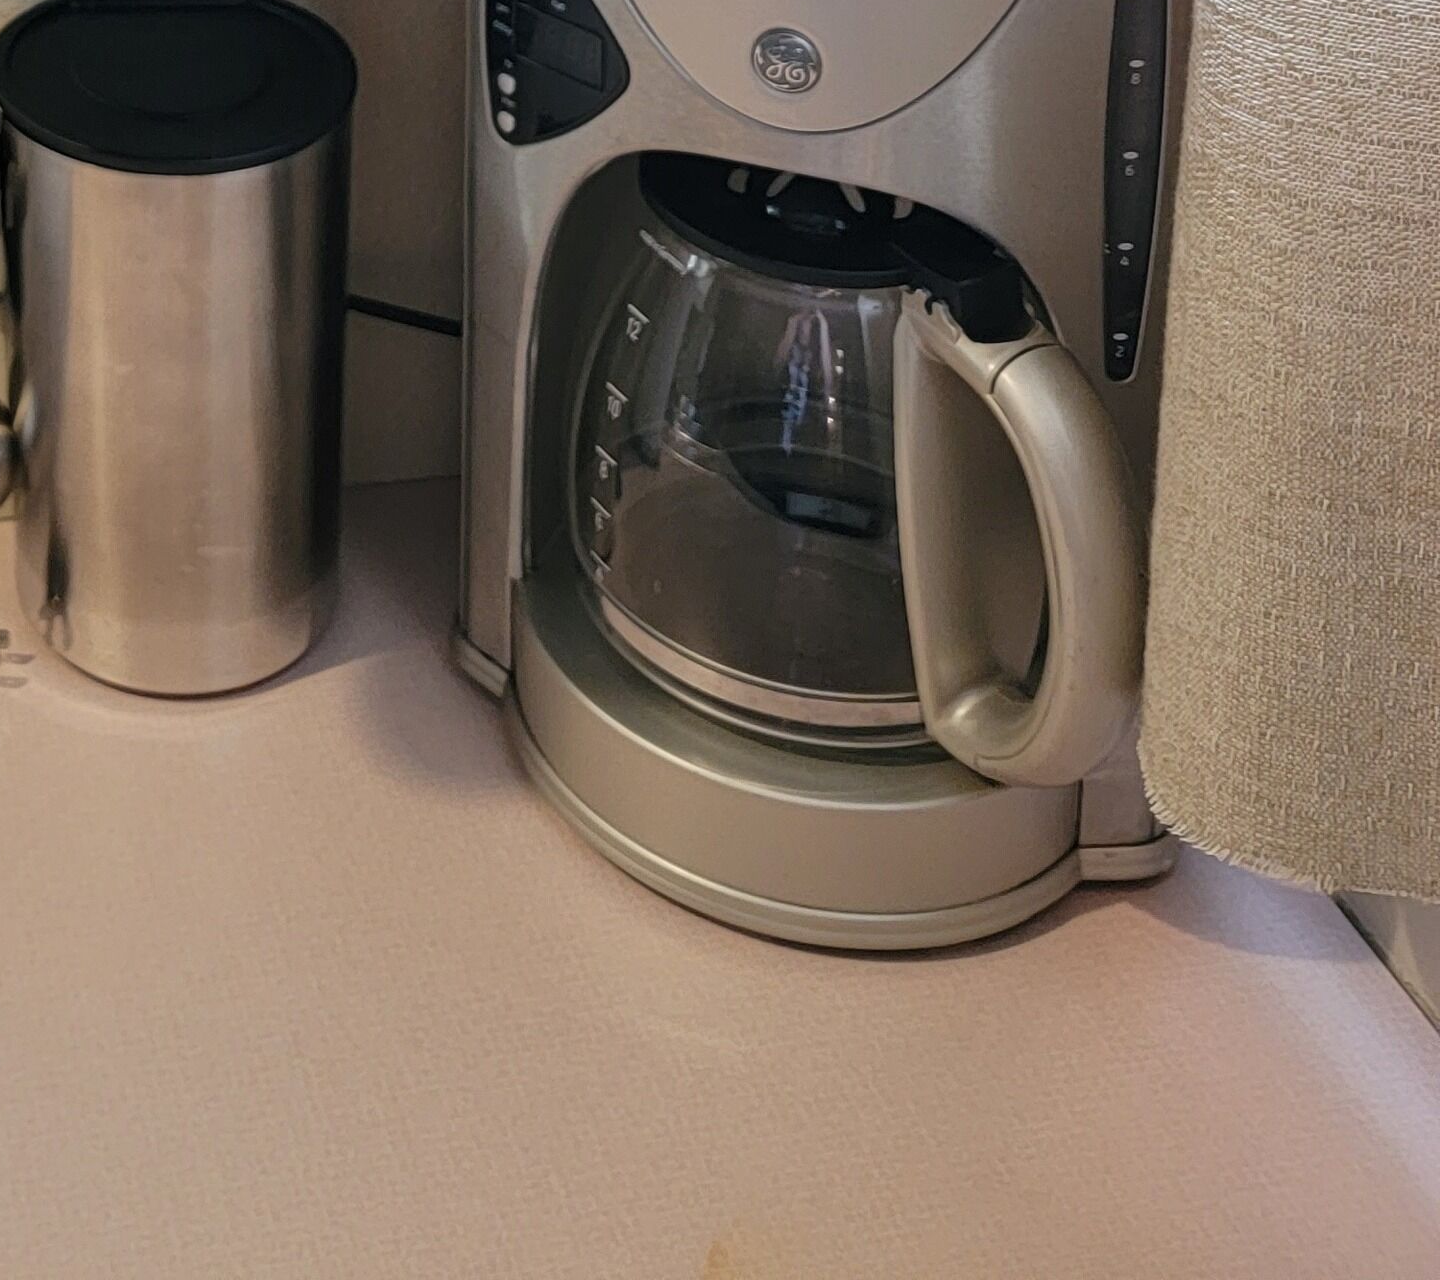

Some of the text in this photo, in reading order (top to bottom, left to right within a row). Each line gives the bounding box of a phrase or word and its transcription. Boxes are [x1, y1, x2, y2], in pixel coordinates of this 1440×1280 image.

[1130, 72, 1142, 85] 8
[1124, 164, 1135, 177] 6
[626, 316, 642, 342] 12
[1115, 345, 1126, 358] 2
[607, 395, 622, 420] 10
